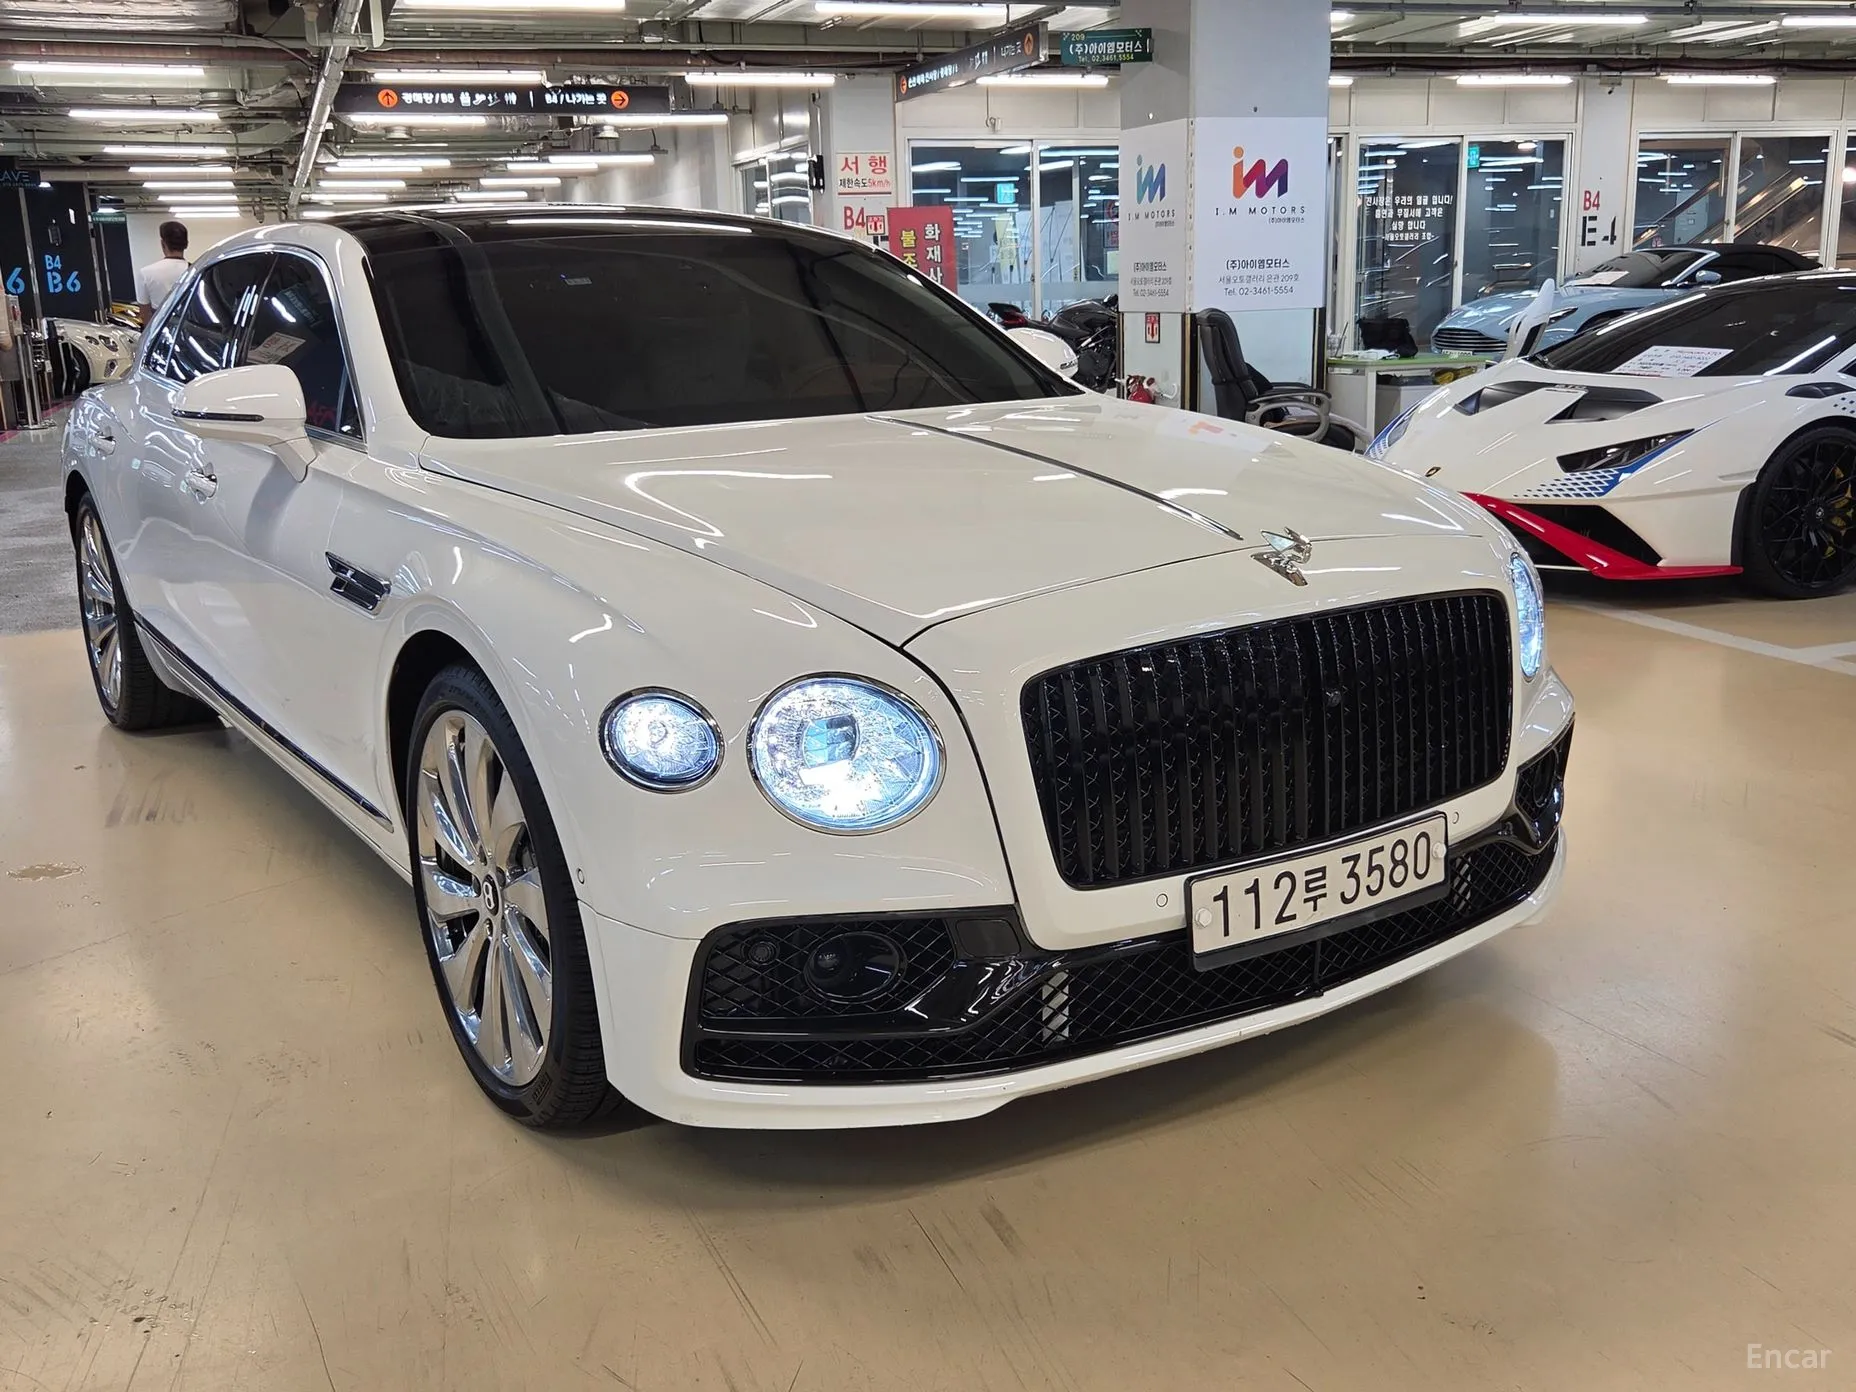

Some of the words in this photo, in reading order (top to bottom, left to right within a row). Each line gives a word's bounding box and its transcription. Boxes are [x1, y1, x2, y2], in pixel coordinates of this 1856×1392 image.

[1071, 33, 1086, 41] 209
[1069, 40, 1142, 55] (주)아이엠모터스
[1583, 190, 1601, 211] B4
[1248, 206, 1305, 215] MOTORS
[843, 206, 866, 231] B4
[45, 254, 62, 270] B4
[1226, 258, 1291, 270] (주)아이엠모터스
[1238, 285, 1294, 296] 02-3461-5554
[1212, 865, 1327, 938] 112루
[1339, 831, 1431, 905] 3580
